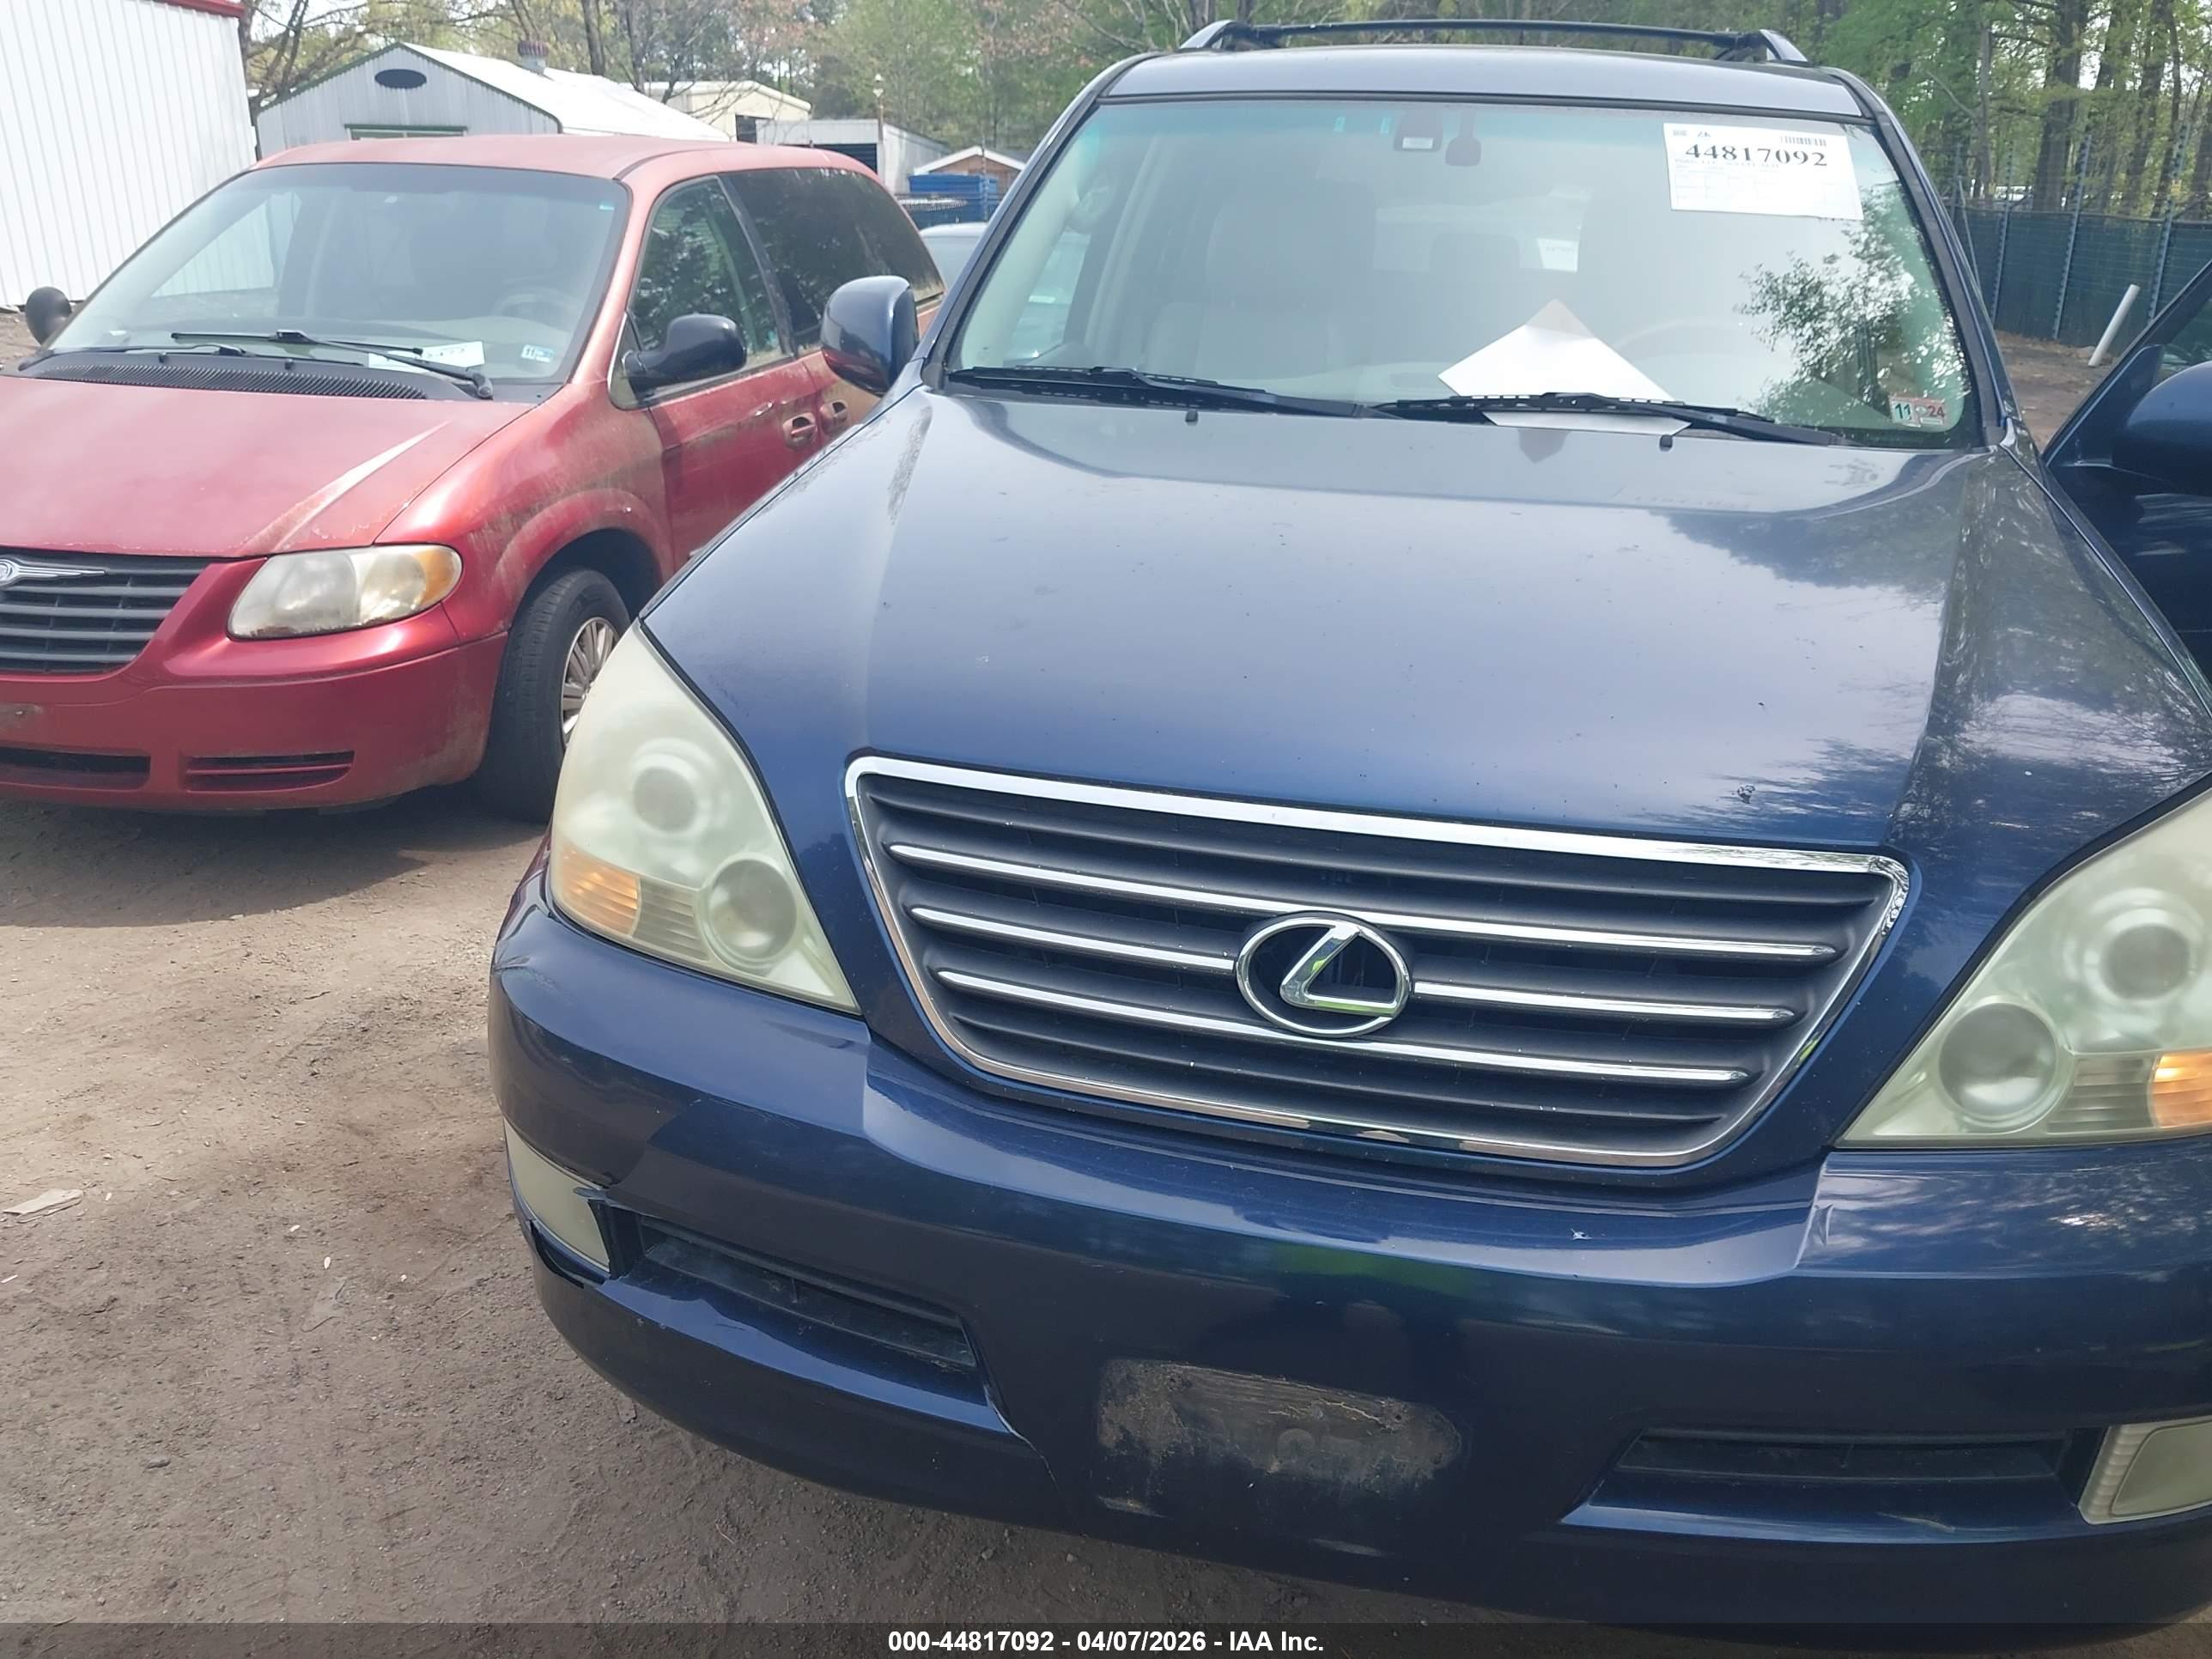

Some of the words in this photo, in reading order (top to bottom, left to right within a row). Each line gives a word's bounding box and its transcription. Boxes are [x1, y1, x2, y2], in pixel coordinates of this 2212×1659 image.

[1685, 143, 1828, 167] 44817092
[1895, 403, 1912, 420] 11
[1928, 405, 1945, 418] 24
